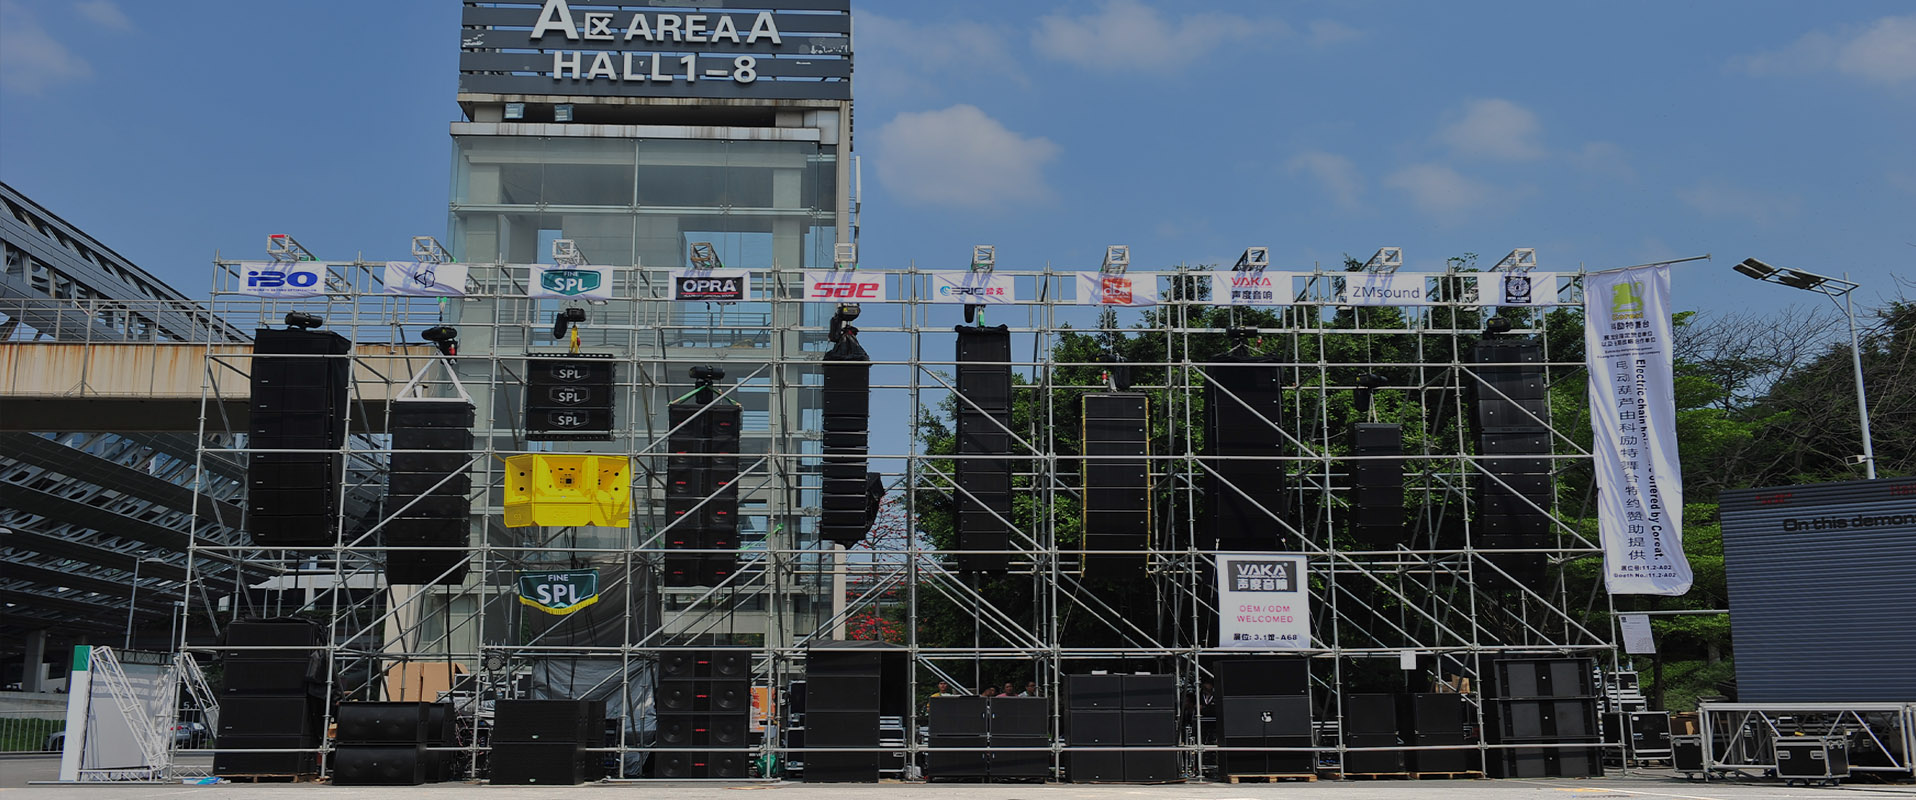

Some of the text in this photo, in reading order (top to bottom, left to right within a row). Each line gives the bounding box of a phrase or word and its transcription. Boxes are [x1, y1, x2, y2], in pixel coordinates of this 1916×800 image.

[623, 13, 740, 44] AREA
[746, 11, 782, 44] A
[553, 51, 673, 82] HALL
[554, 277, 588, 292] SPL
[682, 279, 737, 292] OPRA
[1231, 277, 1272, 286] VAKA
[1231, 290, 1273, 300] 声度音响
[1352, 286, 1420, 298] ZMsound
[558, 369, 582, 379] SPL
[1636, 359, 1647, 396] Electric
[558, 392, 581, 402] SPL
[1637, 399, 1648, 424] chain
[557, 415, 581, 426] SPL
[1648, 512, 1661, 524] by
[1783, 518, 1809, 532] On
[1811, 516, 1848, 530] this
[1236, 564, 1287, 576] VAKA
[547, 574, 569, 582] FINE
[536, 583, 581, 604] SPL
[1268, 605, 1291, 613] ODM
